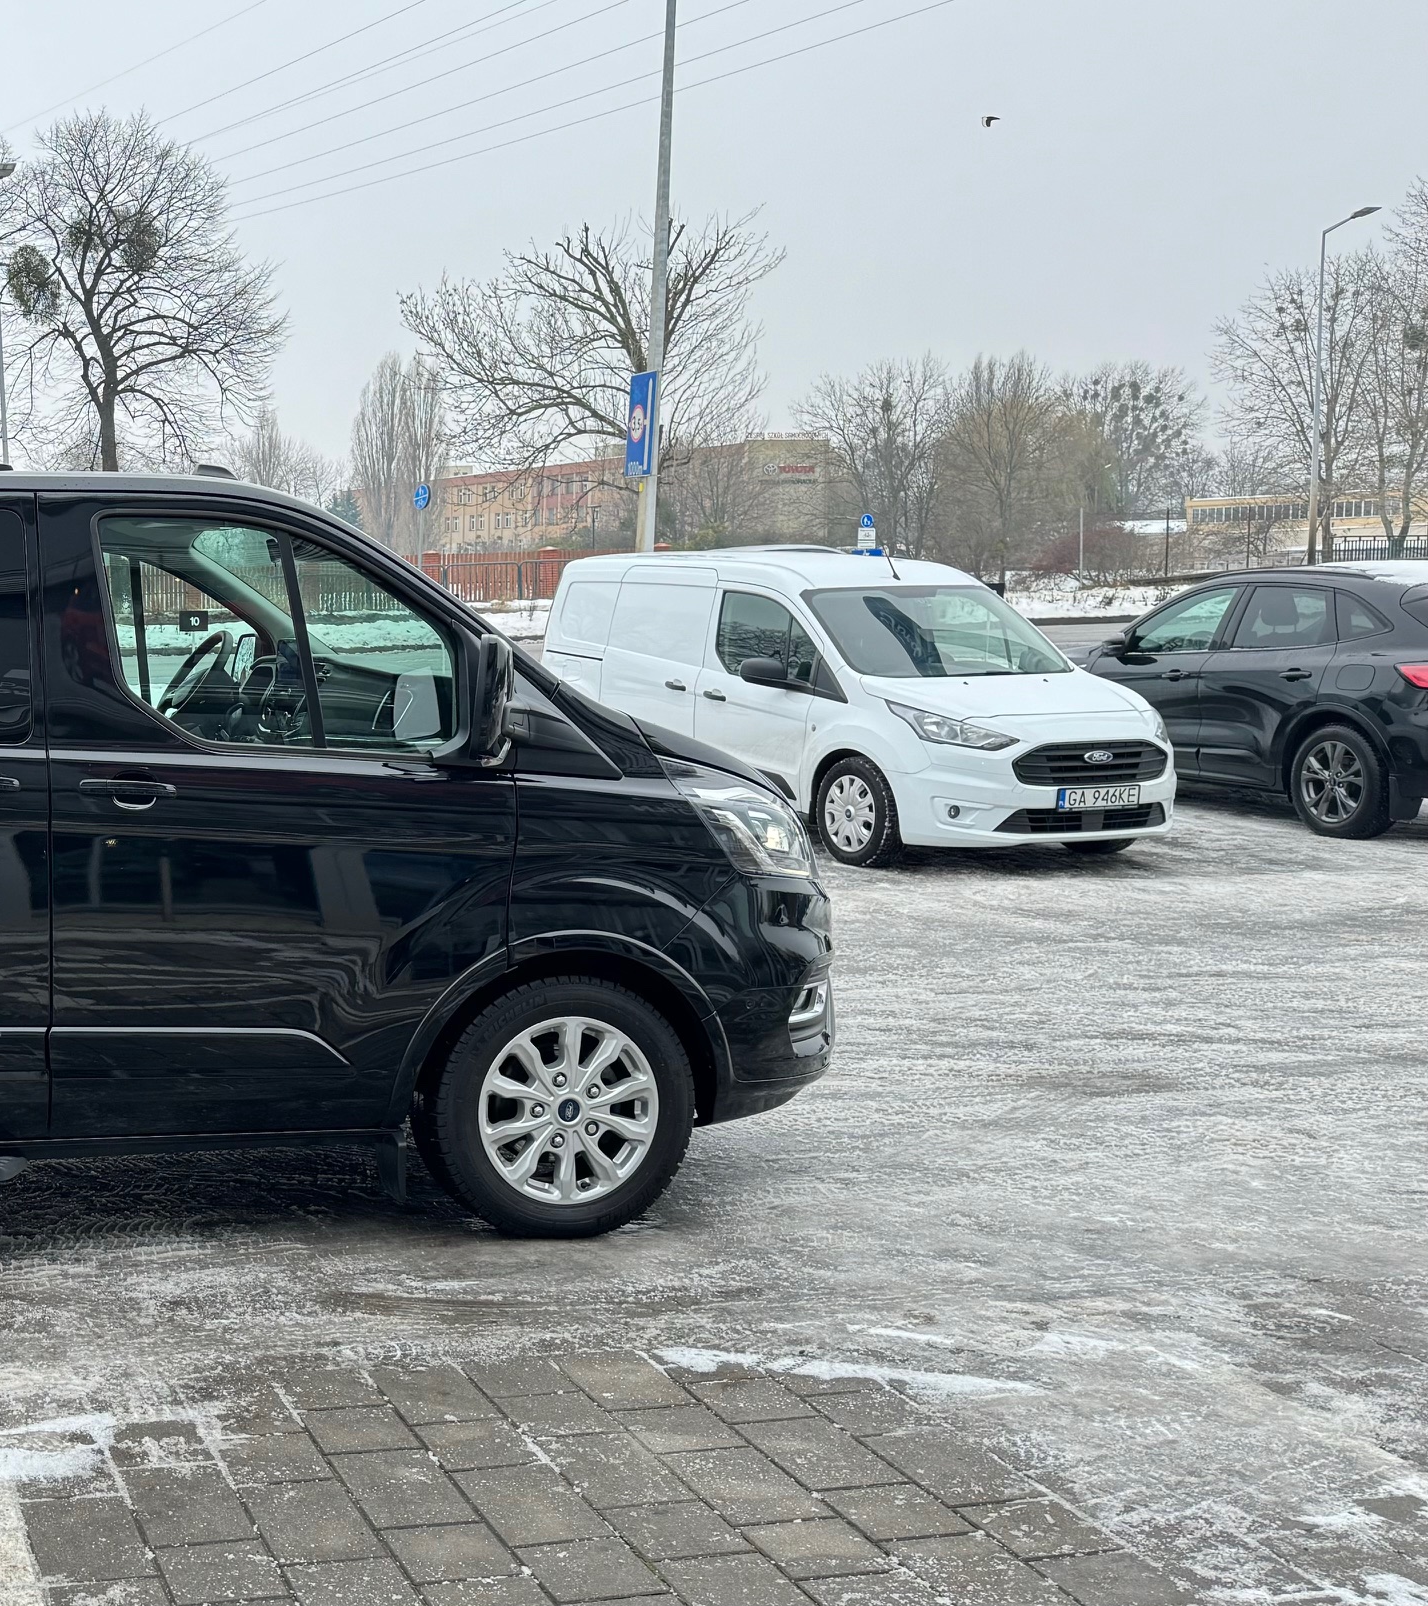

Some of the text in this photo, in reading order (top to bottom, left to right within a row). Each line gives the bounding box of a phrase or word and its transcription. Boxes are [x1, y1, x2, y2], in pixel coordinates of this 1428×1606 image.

[778, 464, 816, 474] TOYOTA
[189, 616, 200, 626] 10
[1068, 787, 1137, 806] GA 946KE
[483, 993, 547, 1041] MICHELIN
